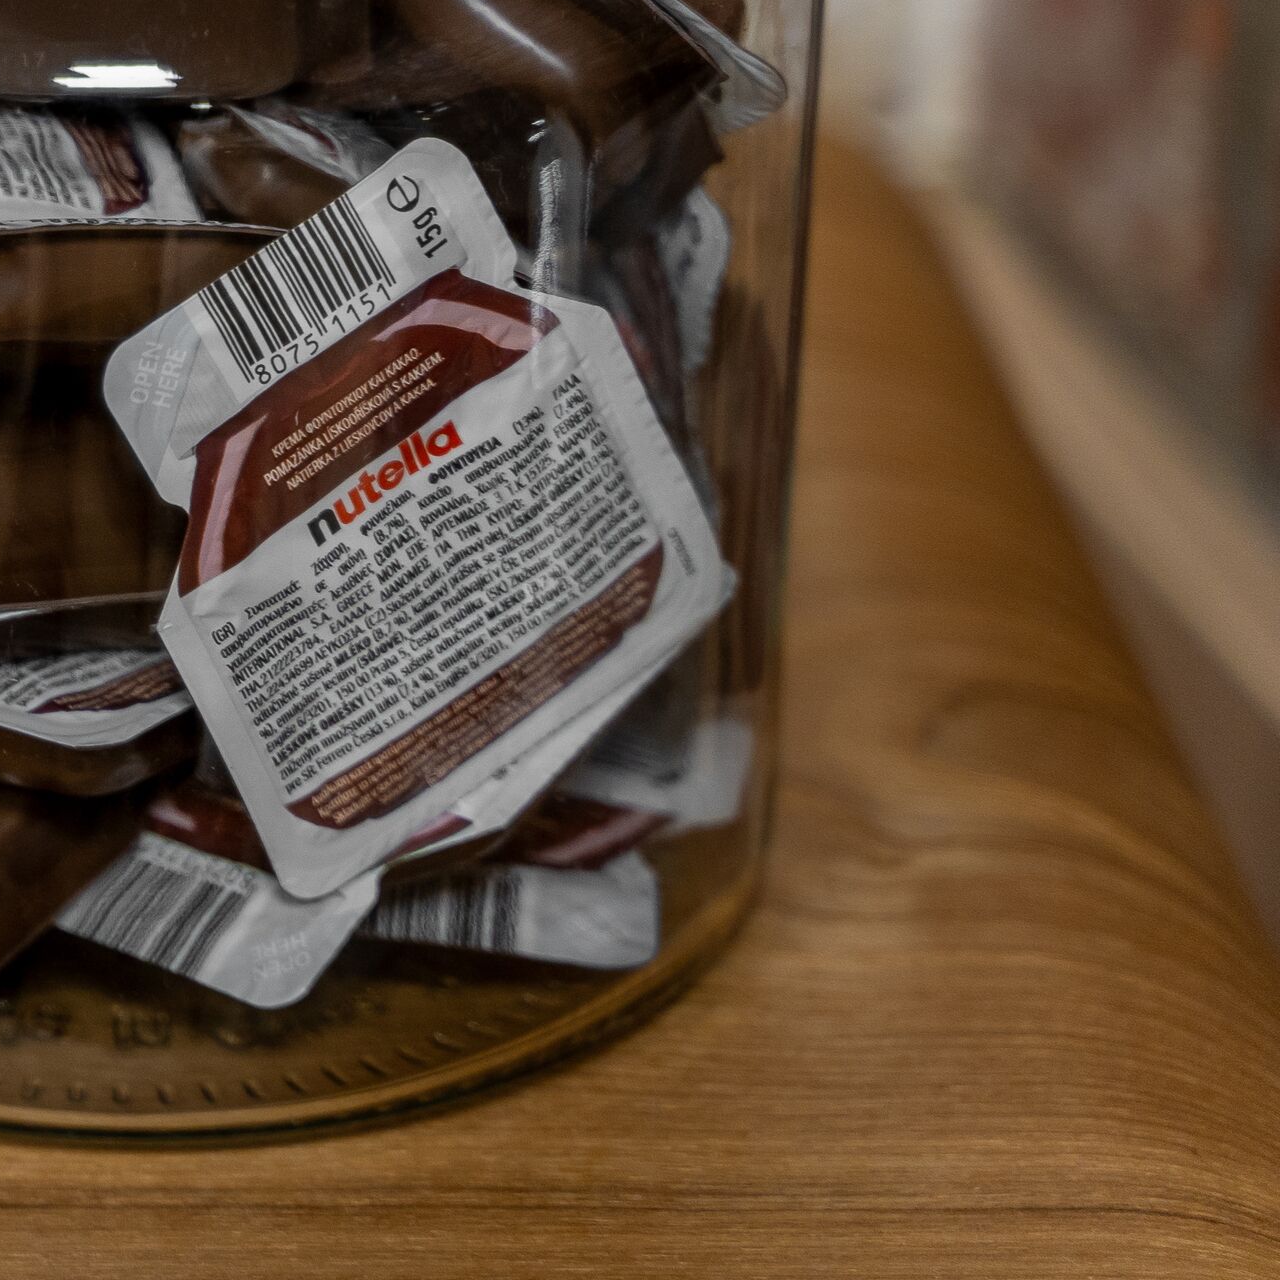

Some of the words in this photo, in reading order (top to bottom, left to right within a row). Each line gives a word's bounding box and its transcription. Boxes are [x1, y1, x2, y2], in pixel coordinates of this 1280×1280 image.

[416, 207, 451, 261] 15g
[130, 339, 164, 405] OPEN
[153, 347, 188, 410] HERE
[253, 335, 320, 387] 8075
[330, 282, 394, 337] 1151
[261, 433, 325, 486] POMAZÁNKA
[390, 380, 401, 392] S
[398, 348, 445, 388] KAKAEM.
[283, 448, 334, 491] NÁTIERKA
[330, 445, 341, 457] Z
[391, 400, 401, 412] A
[298, 409, 465, 548] nutella
